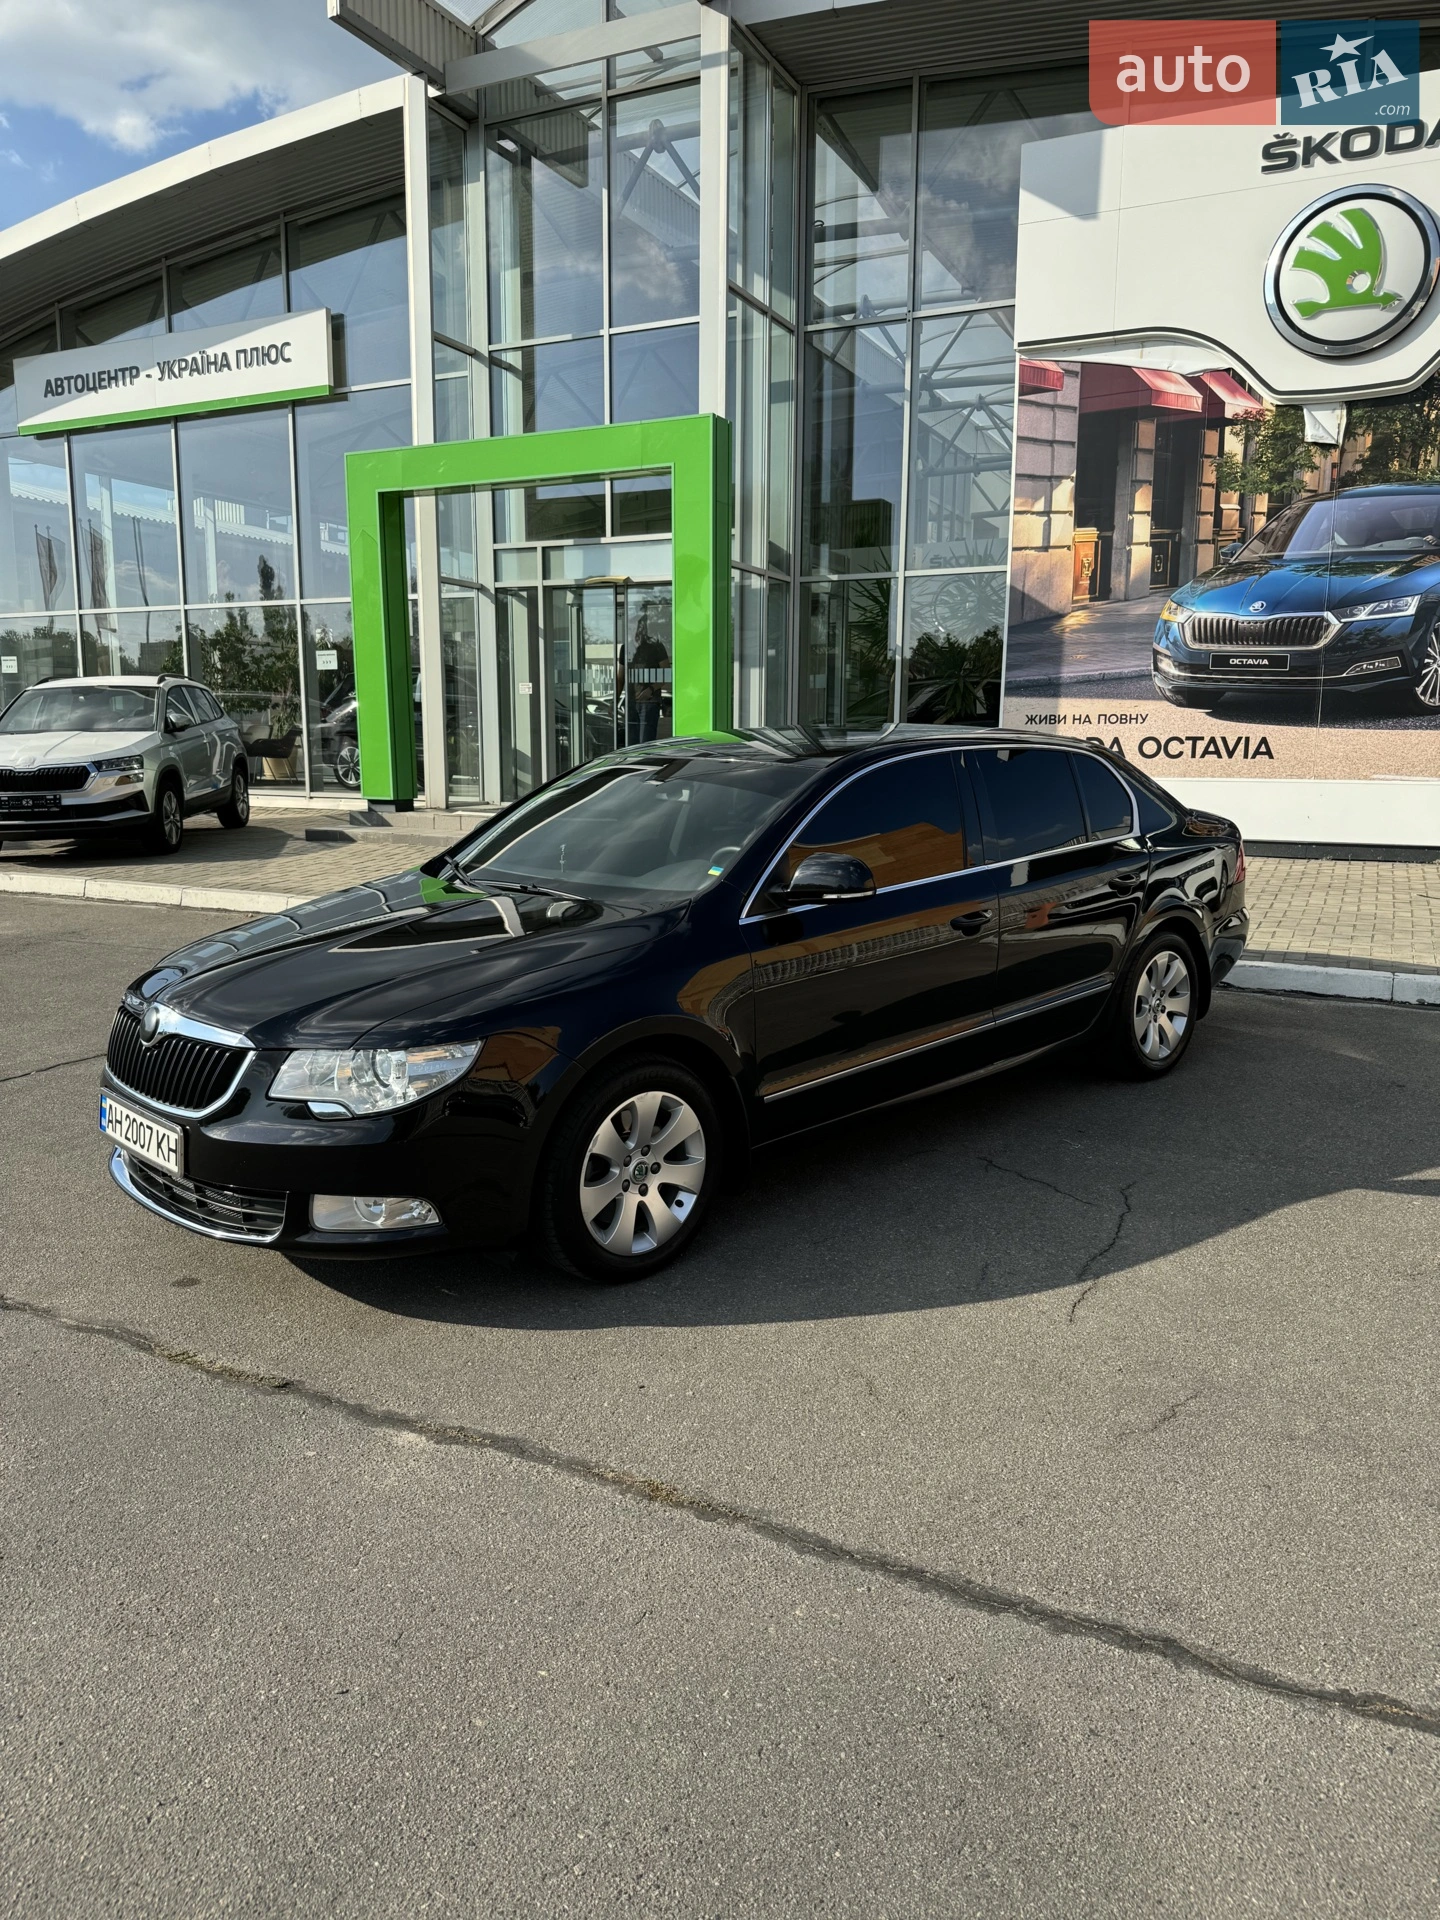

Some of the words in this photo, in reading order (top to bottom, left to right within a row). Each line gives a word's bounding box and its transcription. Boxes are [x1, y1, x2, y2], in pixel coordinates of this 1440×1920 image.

[44, 365, 140, 398] АВТОЦЕНТР
[156, 350, 232, 381] УКРАЇНА
[236, 342, 292, 370] ПЛЮС
[1025, 714, 1067, 725] ЖИВИ
[1072, 714, 1092, 725] НА
[1097, 713, 1149, 725] ПОВНУ
[1137, 736, 1275, 760] OCTAVIA
[106, 1103, 123, 1138] AH
[124, 1114, 153, 1153] 2007
[156, 1129, 178, 1167] KH
